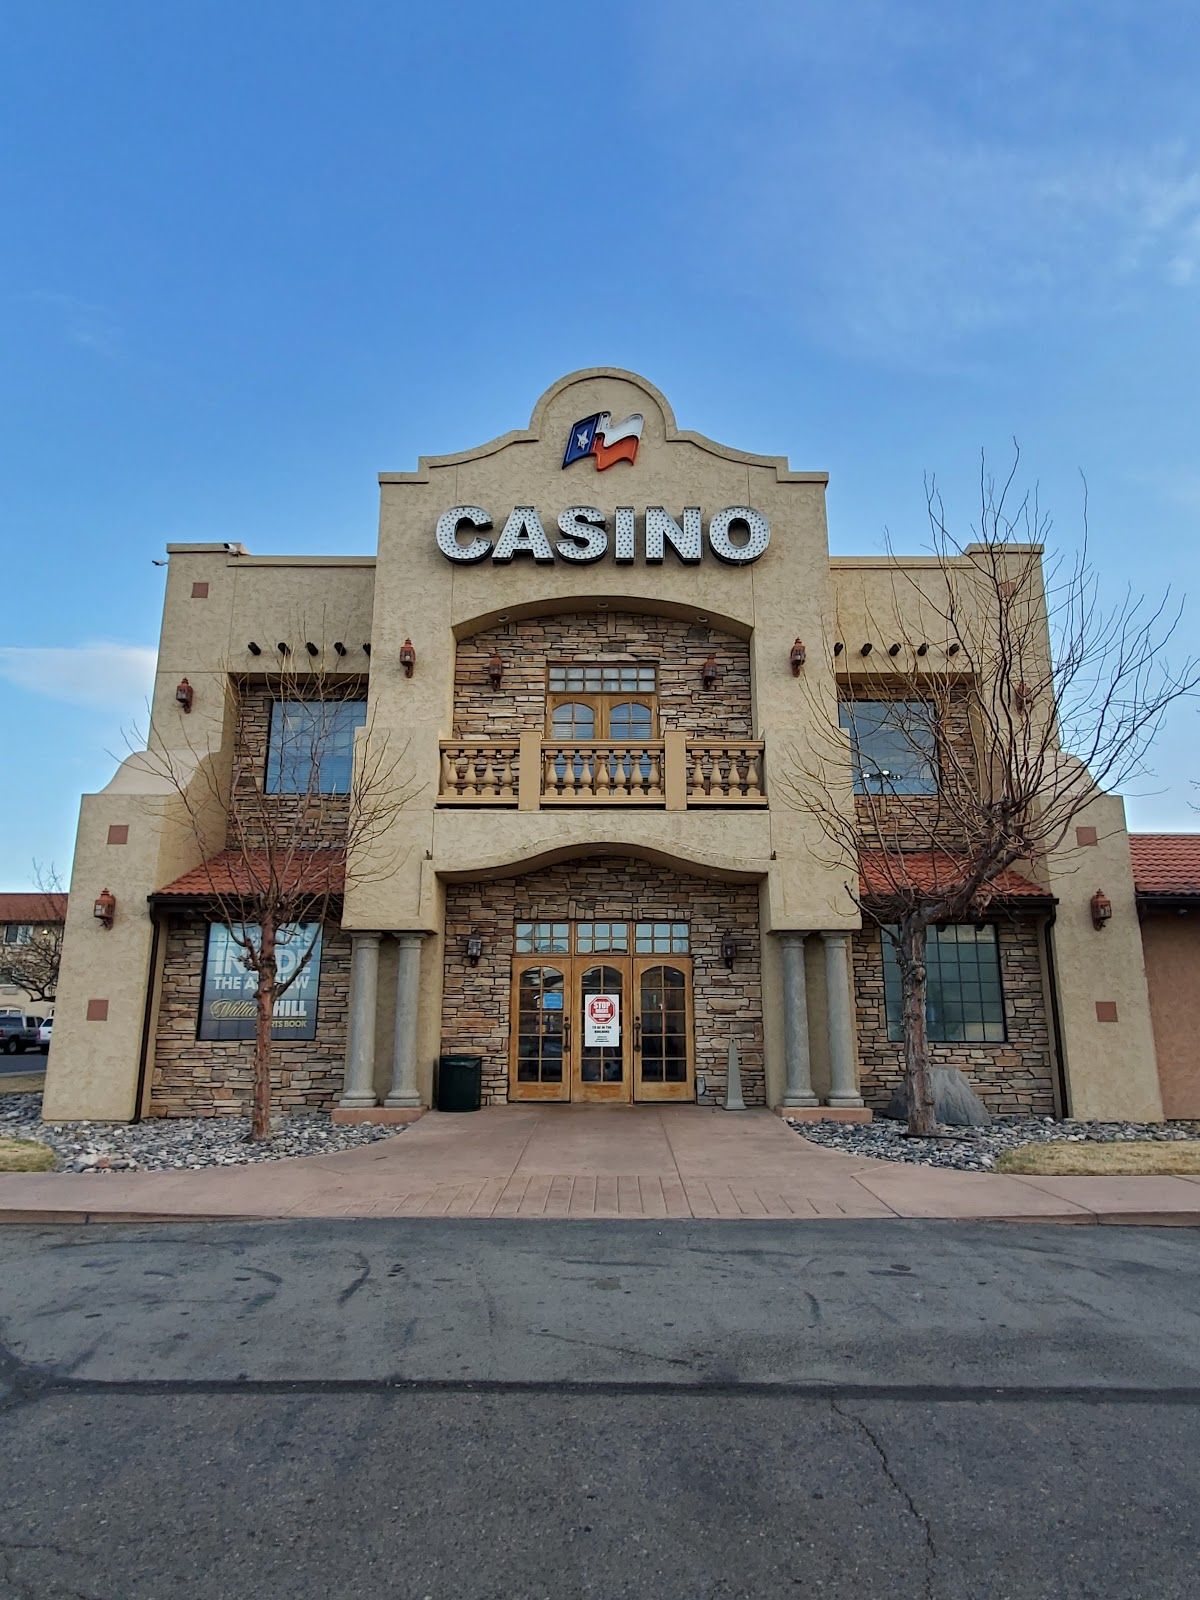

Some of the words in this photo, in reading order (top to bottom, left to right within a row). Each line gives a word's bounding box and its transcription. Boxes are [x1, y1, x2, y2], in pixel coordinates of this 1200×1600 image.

[436, 505, 770, 564] CASINO
[214, 976, 241, 989] THE
[211, 999, 257, 1018] Willia
[272, 1001, 307, 1016] HILL
[284, 1020, 308, 1028] BOOK
